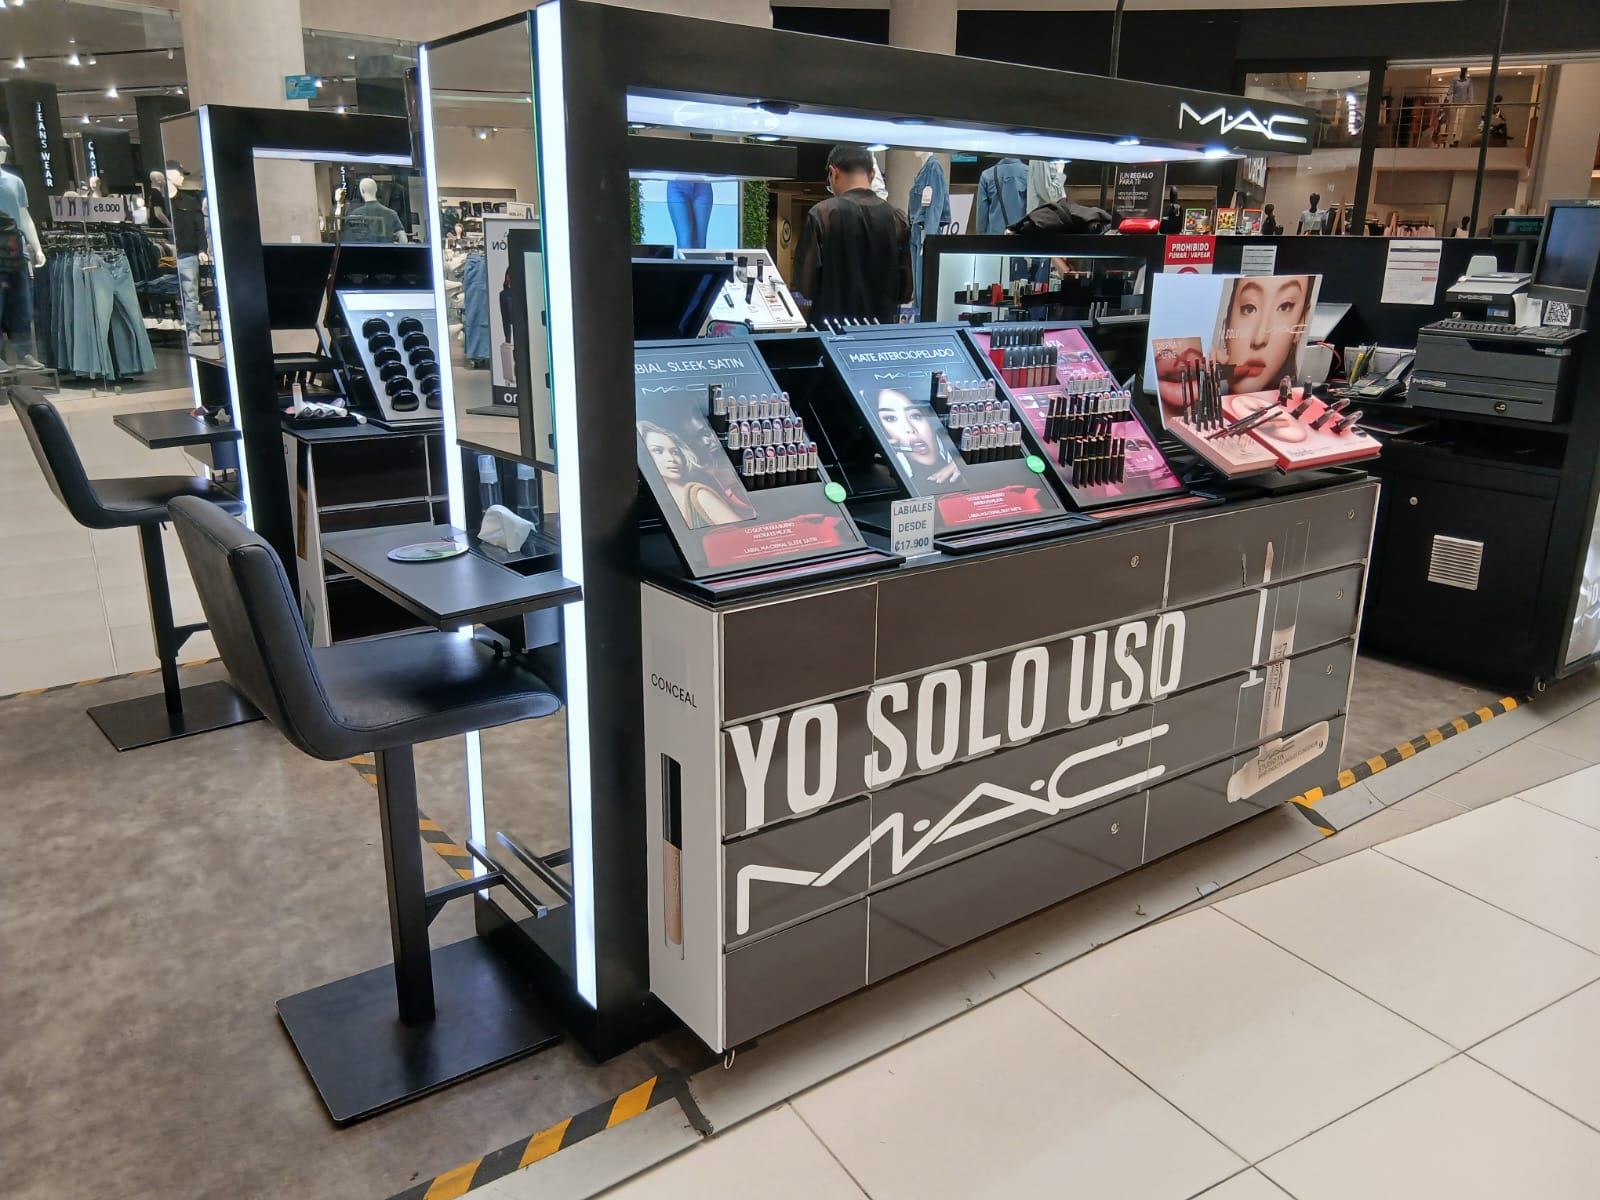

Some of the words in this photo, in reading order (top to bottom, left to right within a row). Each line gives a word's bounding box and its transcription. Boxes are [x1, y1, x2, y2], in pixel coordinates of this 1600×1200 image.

[36, 102, 48, 149] JEANS
[41, 152, 54, 187] WEAR
[1171, 243, 1210, 251] PROHIBIDO
[1168, 251, 1187, 259] FUMAR
[848, 352, 877, 362] MATE
[878, 348, 955, 361] ATERCIOPELADO
[667, 360, 707, 373] SLEEK
[708, 358, 745, 370] SATIN
[893, 502, 933, 516] LABIALES
[898, 520, 927, 533] DESDE
[651, 673, 697, 708] CONCEAL
[728, 703, 838, 831] YO
[863, 646, 1049, 789] SOLO
[1068, 611, 1186, 724] USO
